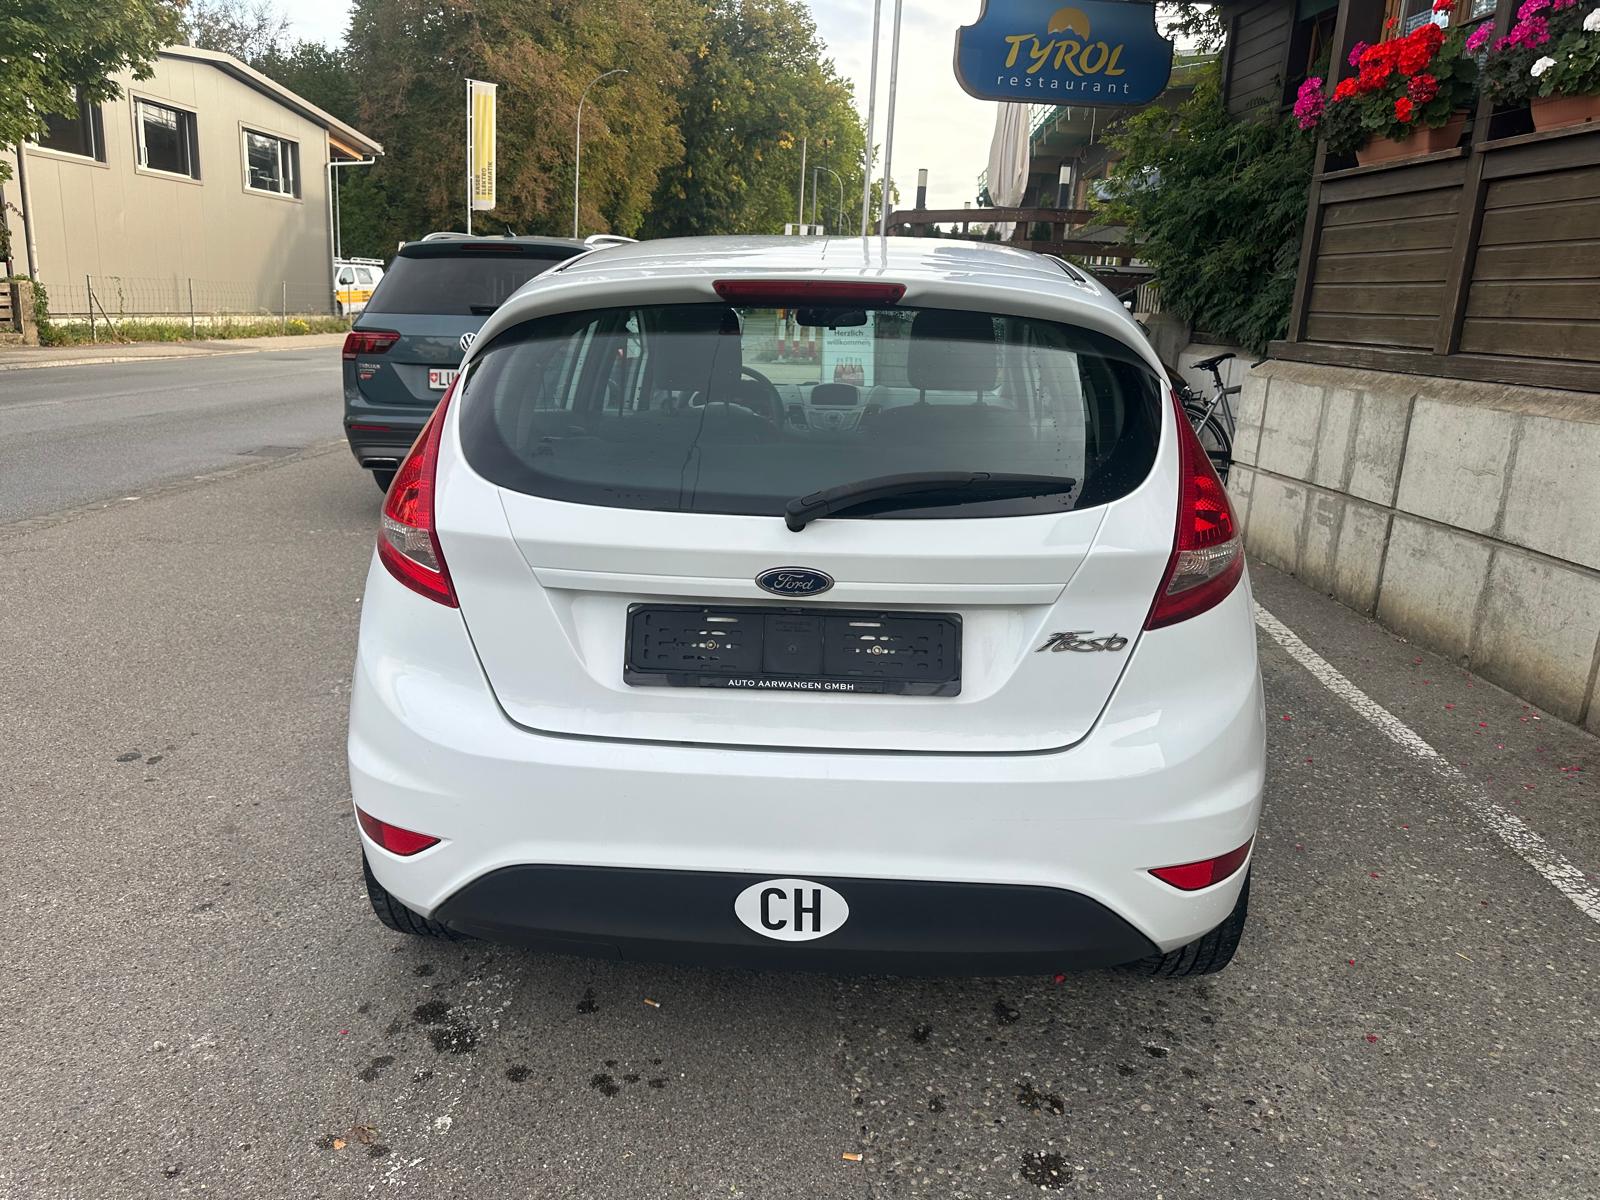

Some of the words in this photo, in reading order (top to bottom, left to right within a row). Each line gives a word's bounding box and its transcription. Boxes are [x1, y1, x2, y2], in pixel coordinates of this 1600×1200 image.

[1004, 33, 1125, 77] TYROL
[997, 74, 1129, 94] restaurant
[834, 329, 864, 337] Herzlich
[773, 573, 815, 590] Ford
[1034, 630, 1129, 653] Fiesta
[728, 679, 755, 687] AUTO
[757, 680, 822, 689] AARWANGEN
[824, 682, 854, 690] GMBH
[760, 887, 822, 932] CH
